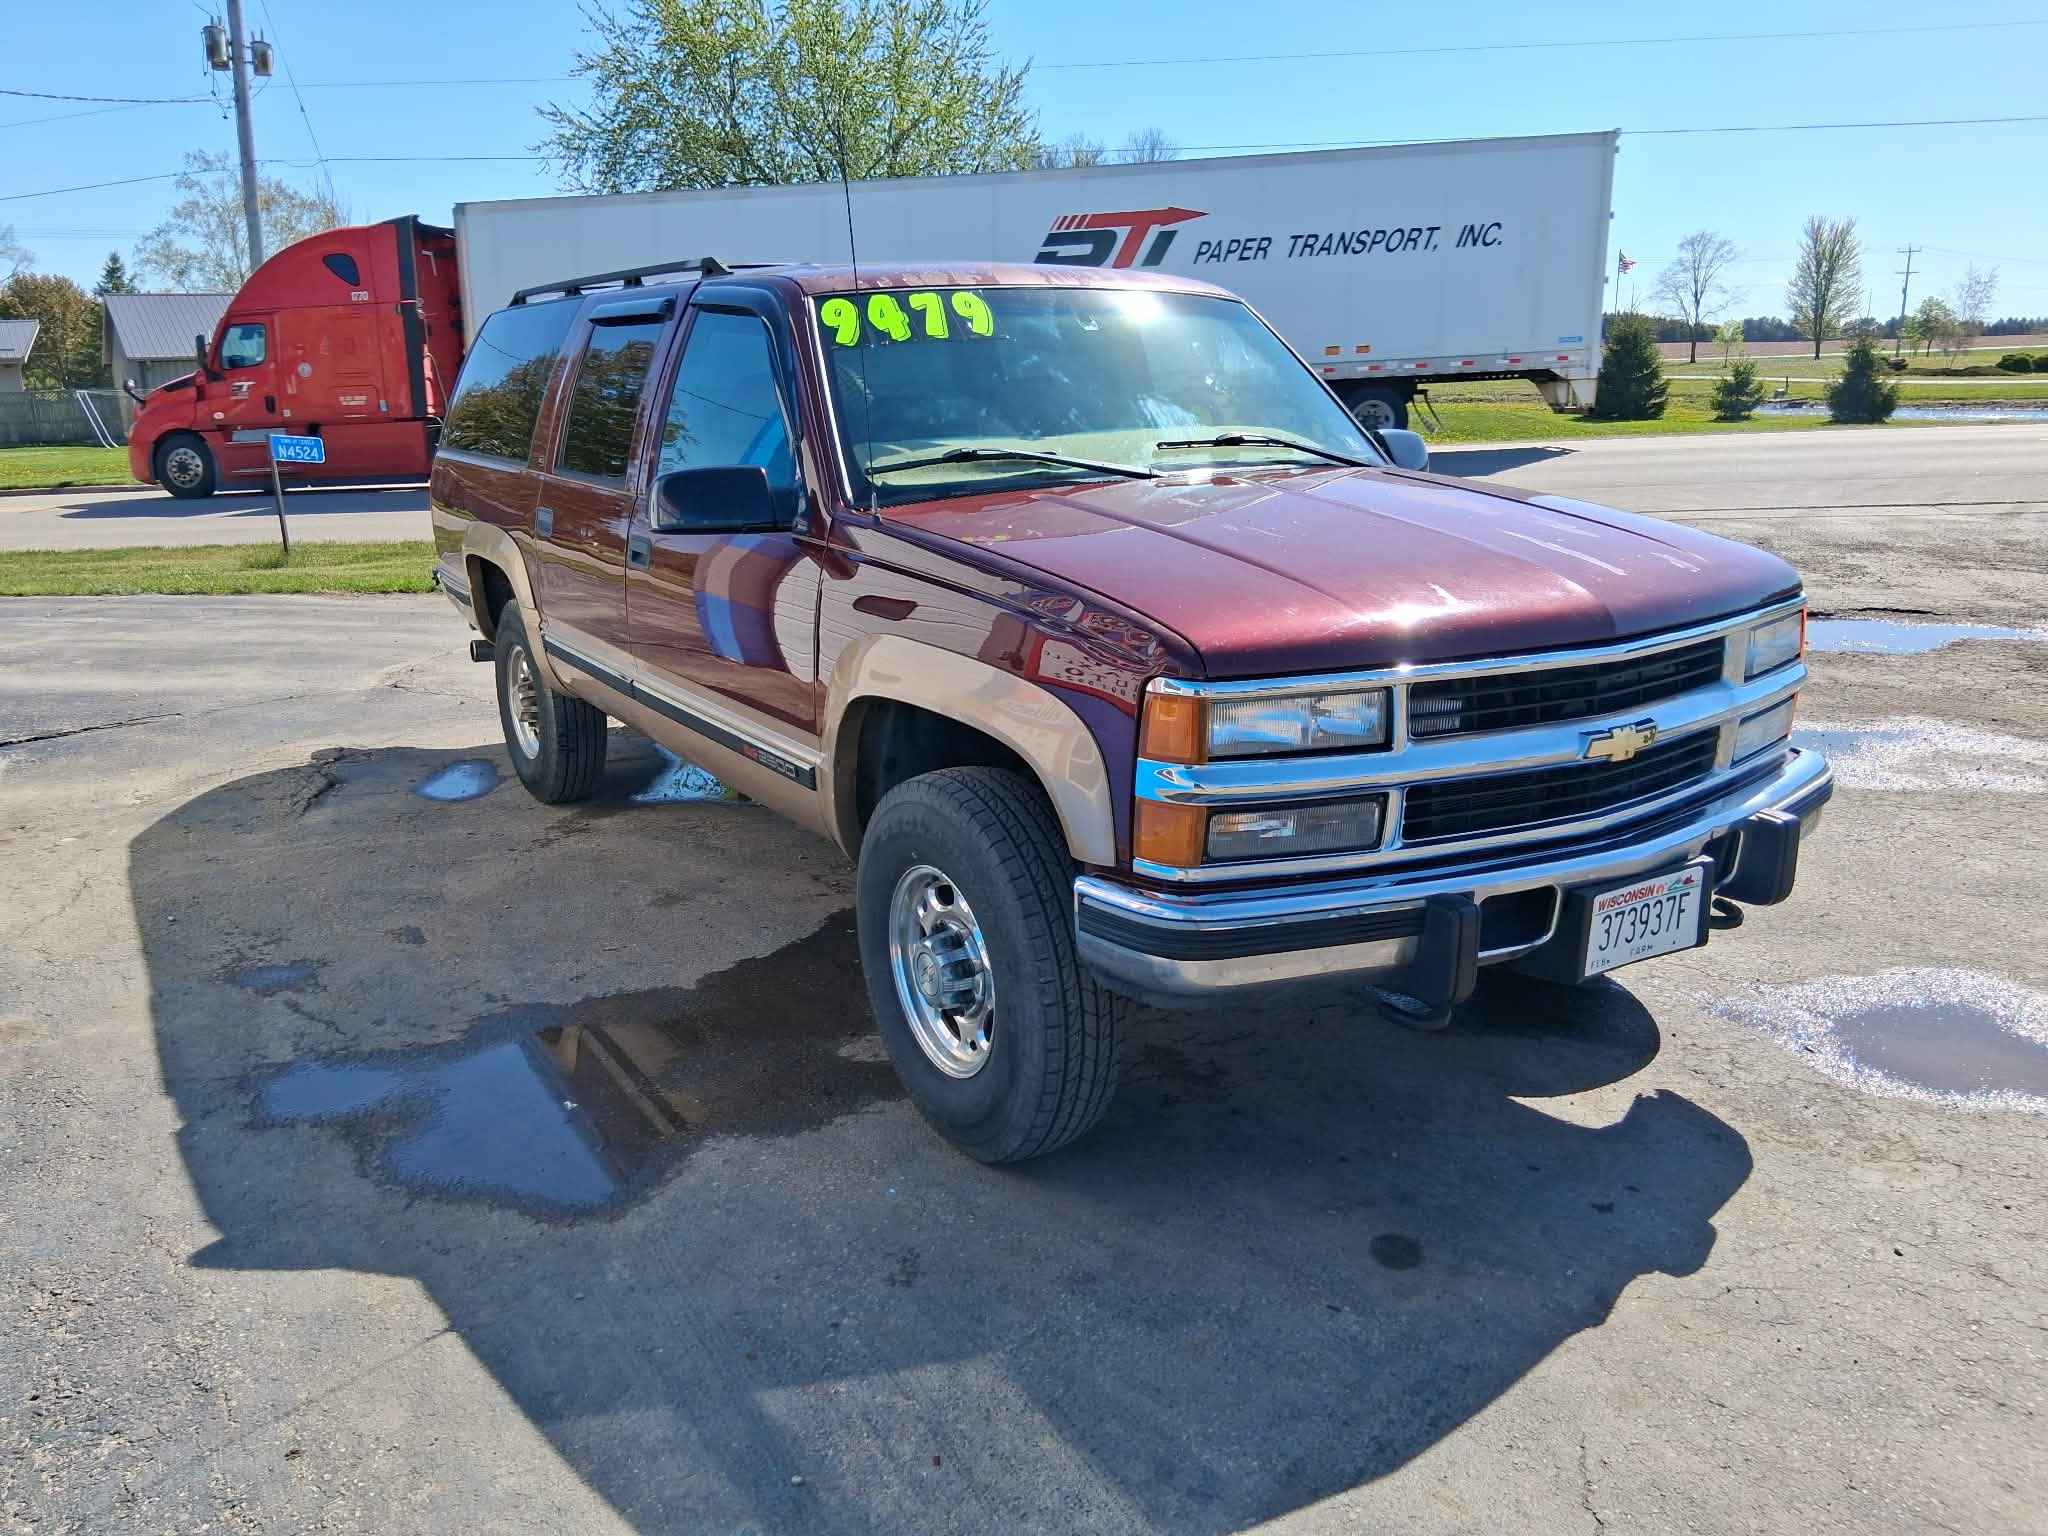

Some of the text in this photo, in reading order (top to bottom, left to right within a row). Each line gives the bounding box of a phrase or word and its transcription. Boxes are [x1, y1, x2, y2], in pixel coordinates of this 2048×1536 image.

[1193, 222, 1503, 265] PAPER TRANSPORT, INC.
[821, 292, 993, 346] 9479
[279, 444, 319, 460] N4524
[1598, 884, 1656, 912] WISCONSIN
[1598, 892, 1691, 951] 373937F
